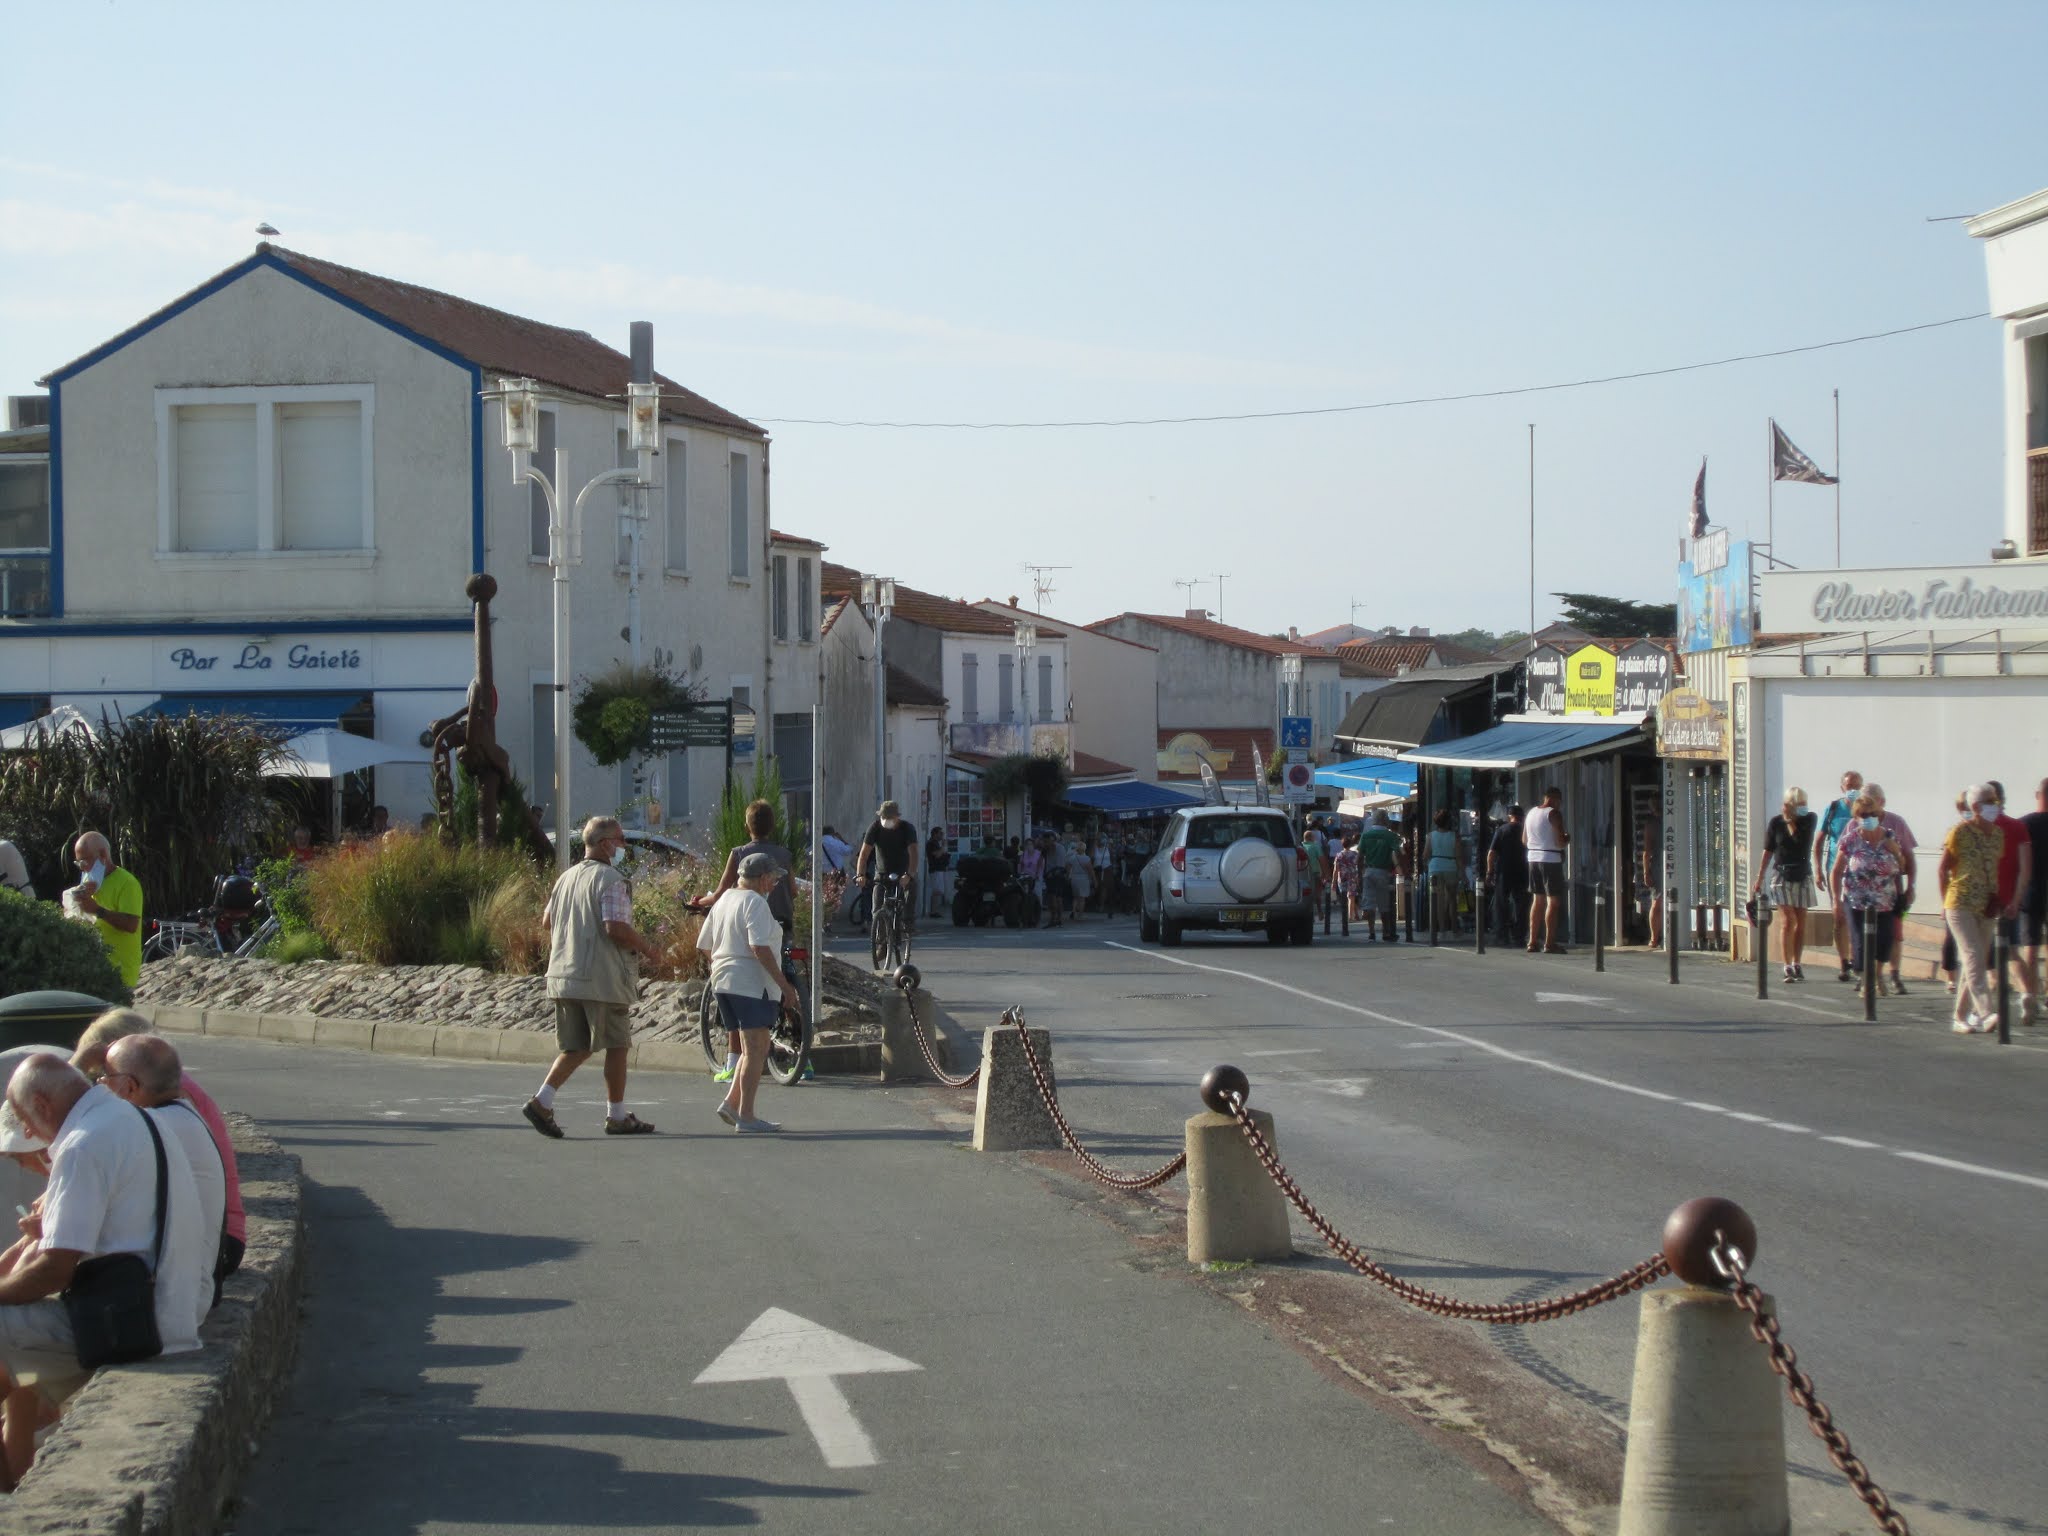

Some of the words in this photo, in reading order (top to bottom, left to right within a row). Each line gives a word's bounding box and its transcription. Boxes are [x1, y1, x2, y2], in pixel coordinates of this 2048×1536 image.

[1919, 576, 2048, 619] Fabrican
[170, 648, 219, 670] Bar
[232, 644, 273, 670] La
[288, 644, 361, 670] Gaieté
[1533, 657, 1558, 676] Souvenirs
[1616, 655, 1624, 673] Les
[1624, 655, 1643, 677] plaisirs
[1644, 654, 1658, 673] d'été
[1567, 688, 1587, 708] Produits
[1588, 687, 1612, 709] Régionaux
[1629, 681, 1646, 711] petits
[1703, 716, 1719, 746] Nacre
[1666, 762, 1674, 815] BIJOUX
[1666, 826, 1674, 879] ARGENT
